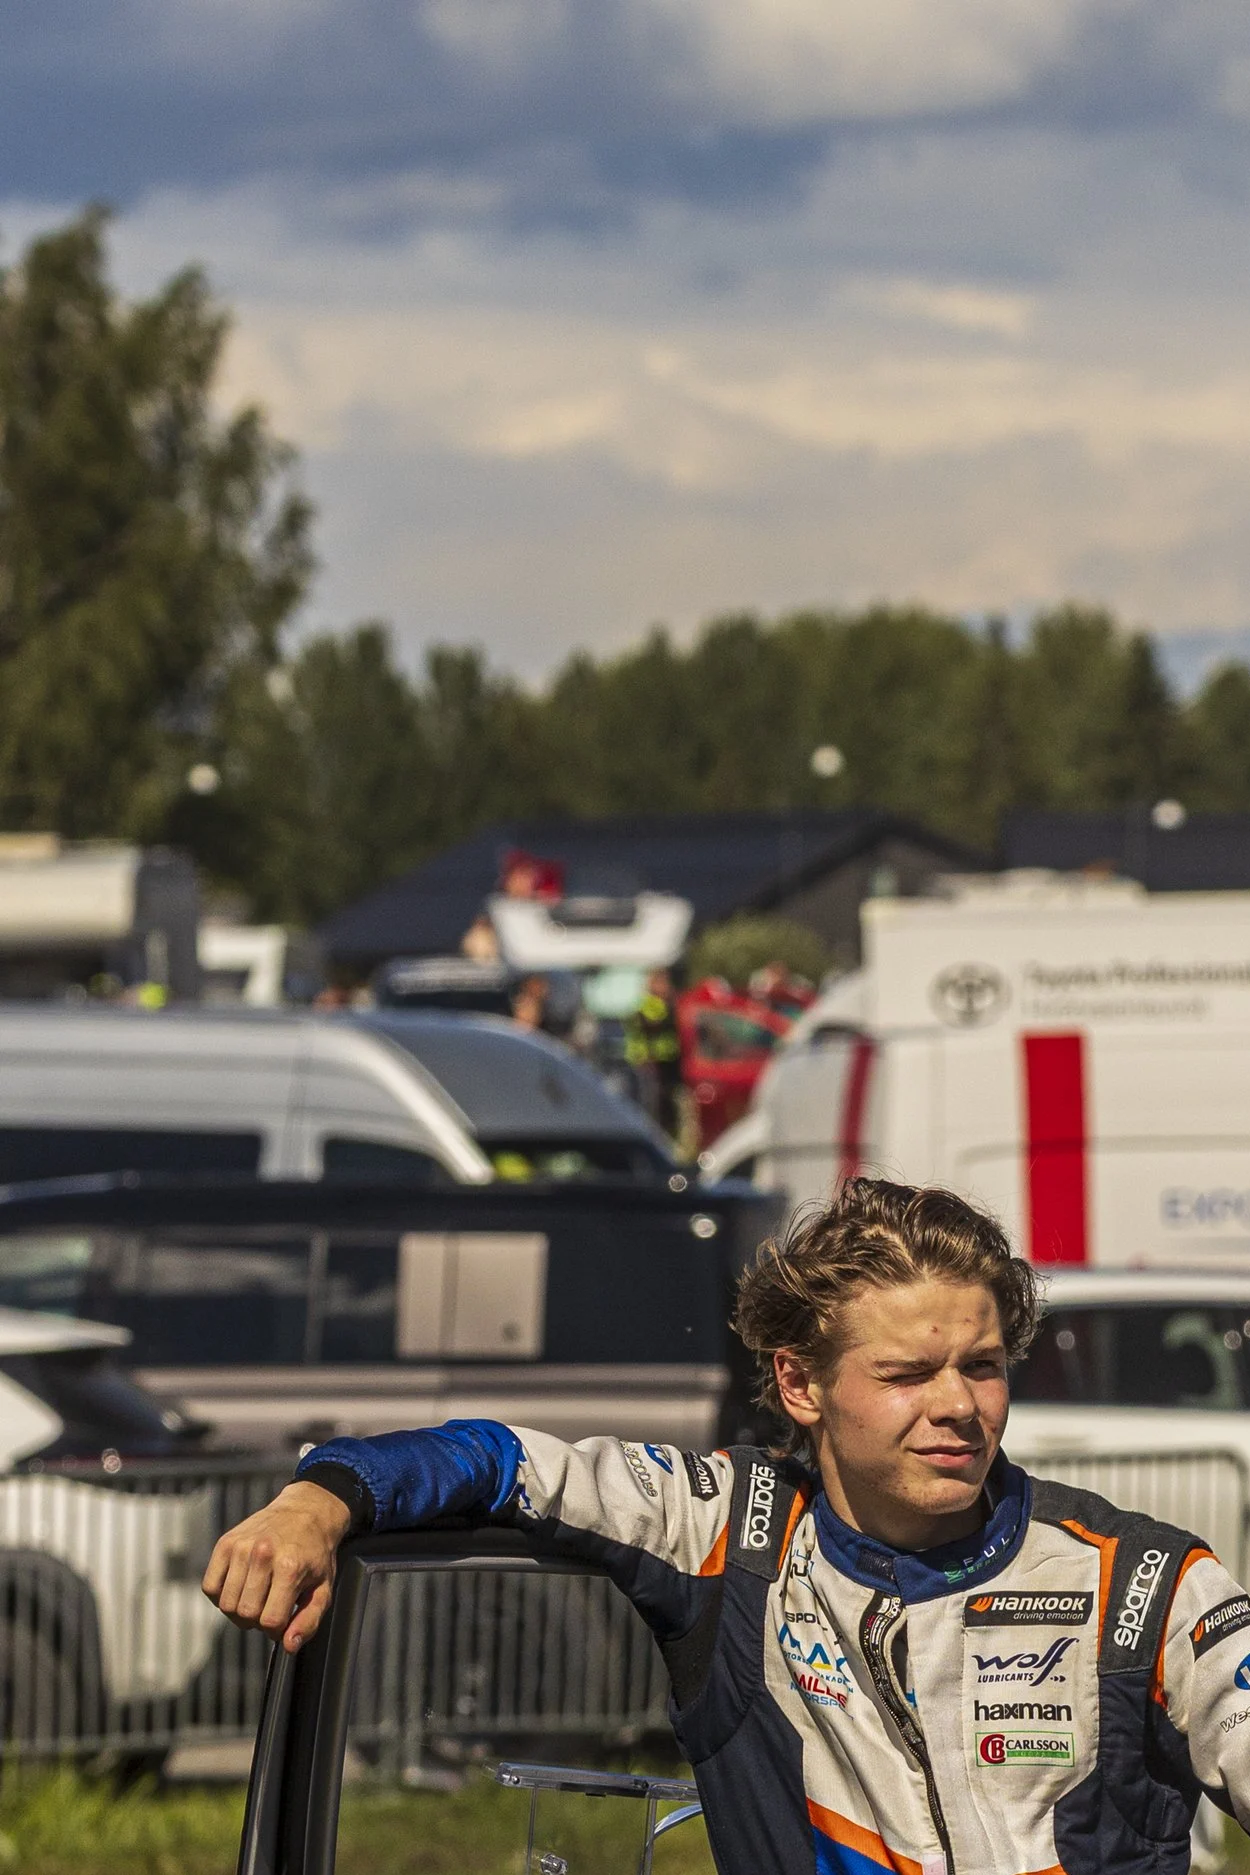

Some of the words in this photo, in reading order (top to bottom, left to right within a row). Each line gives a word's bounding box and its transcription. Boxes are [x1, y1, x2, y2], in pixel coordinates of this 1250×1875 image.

[748, 1462, 777, 1550] sparco
[1114, 1550, 1165, 1648] sparco
[1013, 1611, 1044, 1621] driving
[1046, 1612, 1084, 1621] emotion
[977, 1672, 1035, 1684] LUBRICANTS
[974, 1699, 1073, 1722] haxman
[1006, 1739, 1069, 1752] CARLSSON
